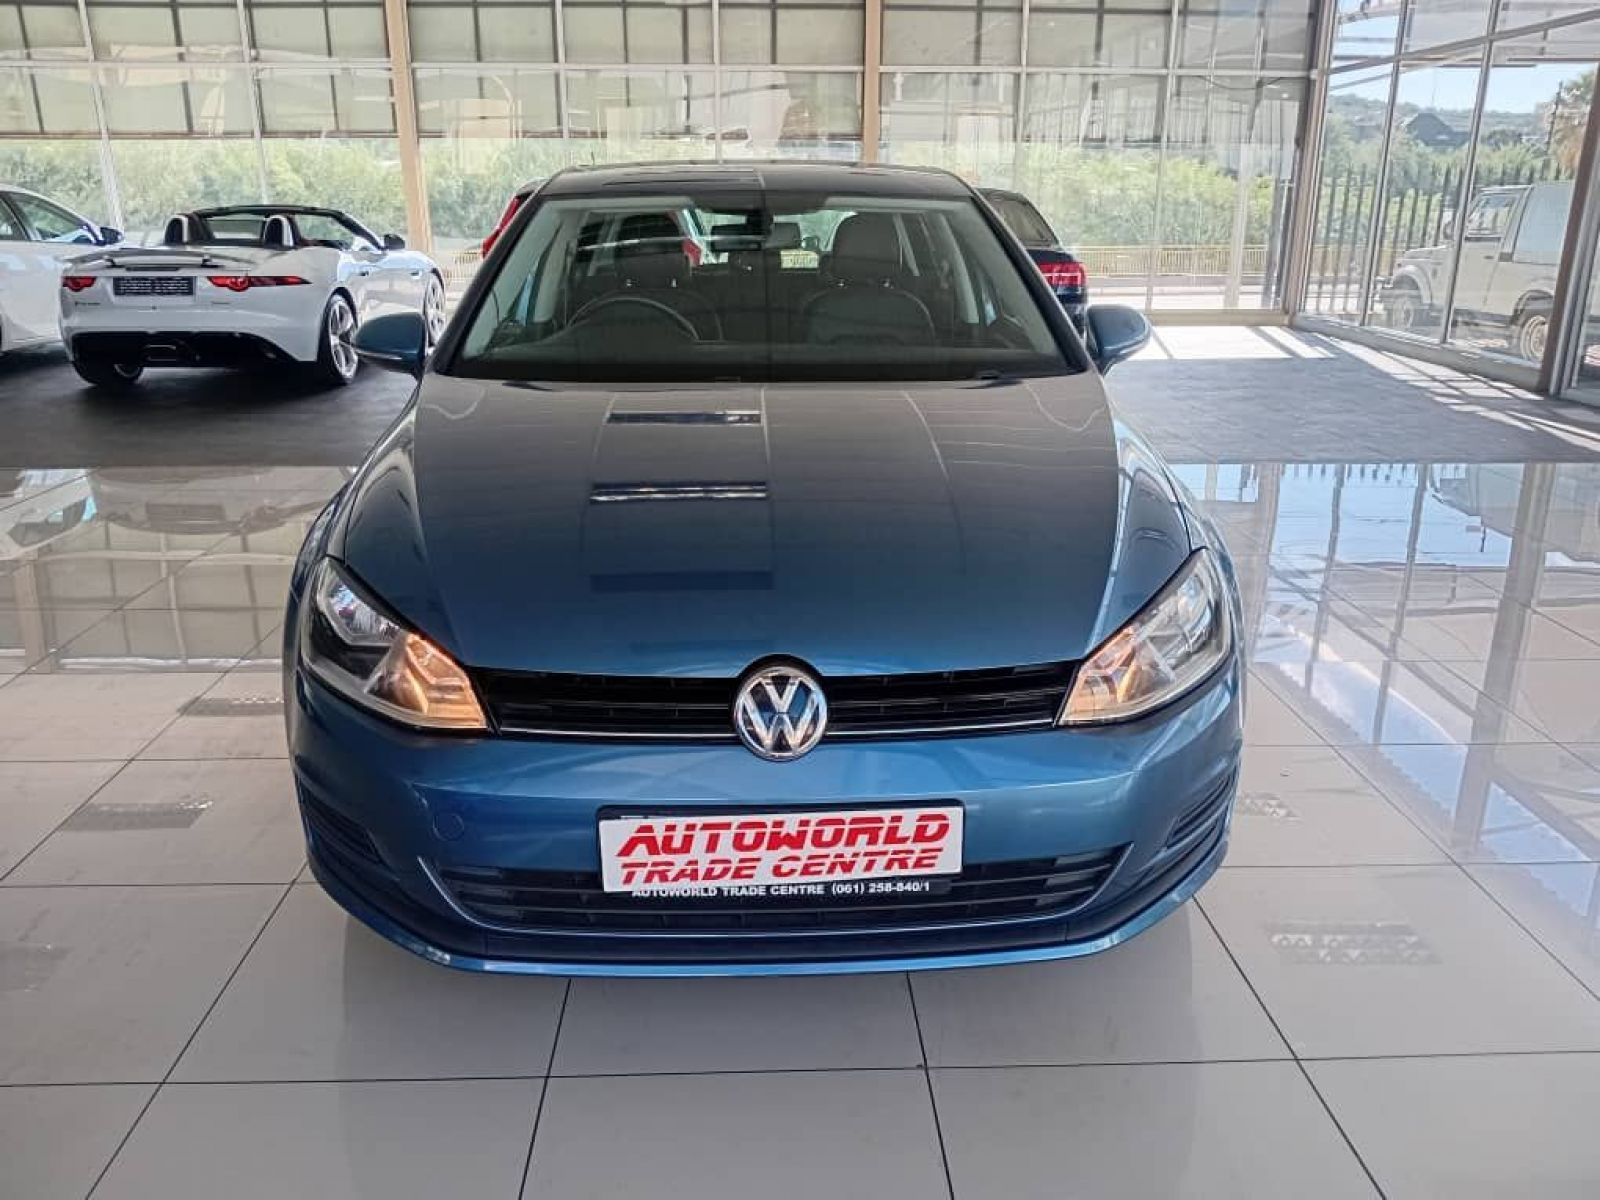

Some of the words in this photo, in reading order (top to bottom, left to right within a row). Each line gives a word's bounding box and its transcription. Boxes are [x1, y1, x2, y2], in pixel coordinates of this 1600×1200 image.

[739, 671, 824, 755] VW
[616, 813, 950, 857] AUTOWORLD
[621, 857, 762, 885] TRADE
[771, 848, 944, 877] CENTRE
[723, 885, 767, 896] TRADE
[770, 884, 825, 895] CENTRE
